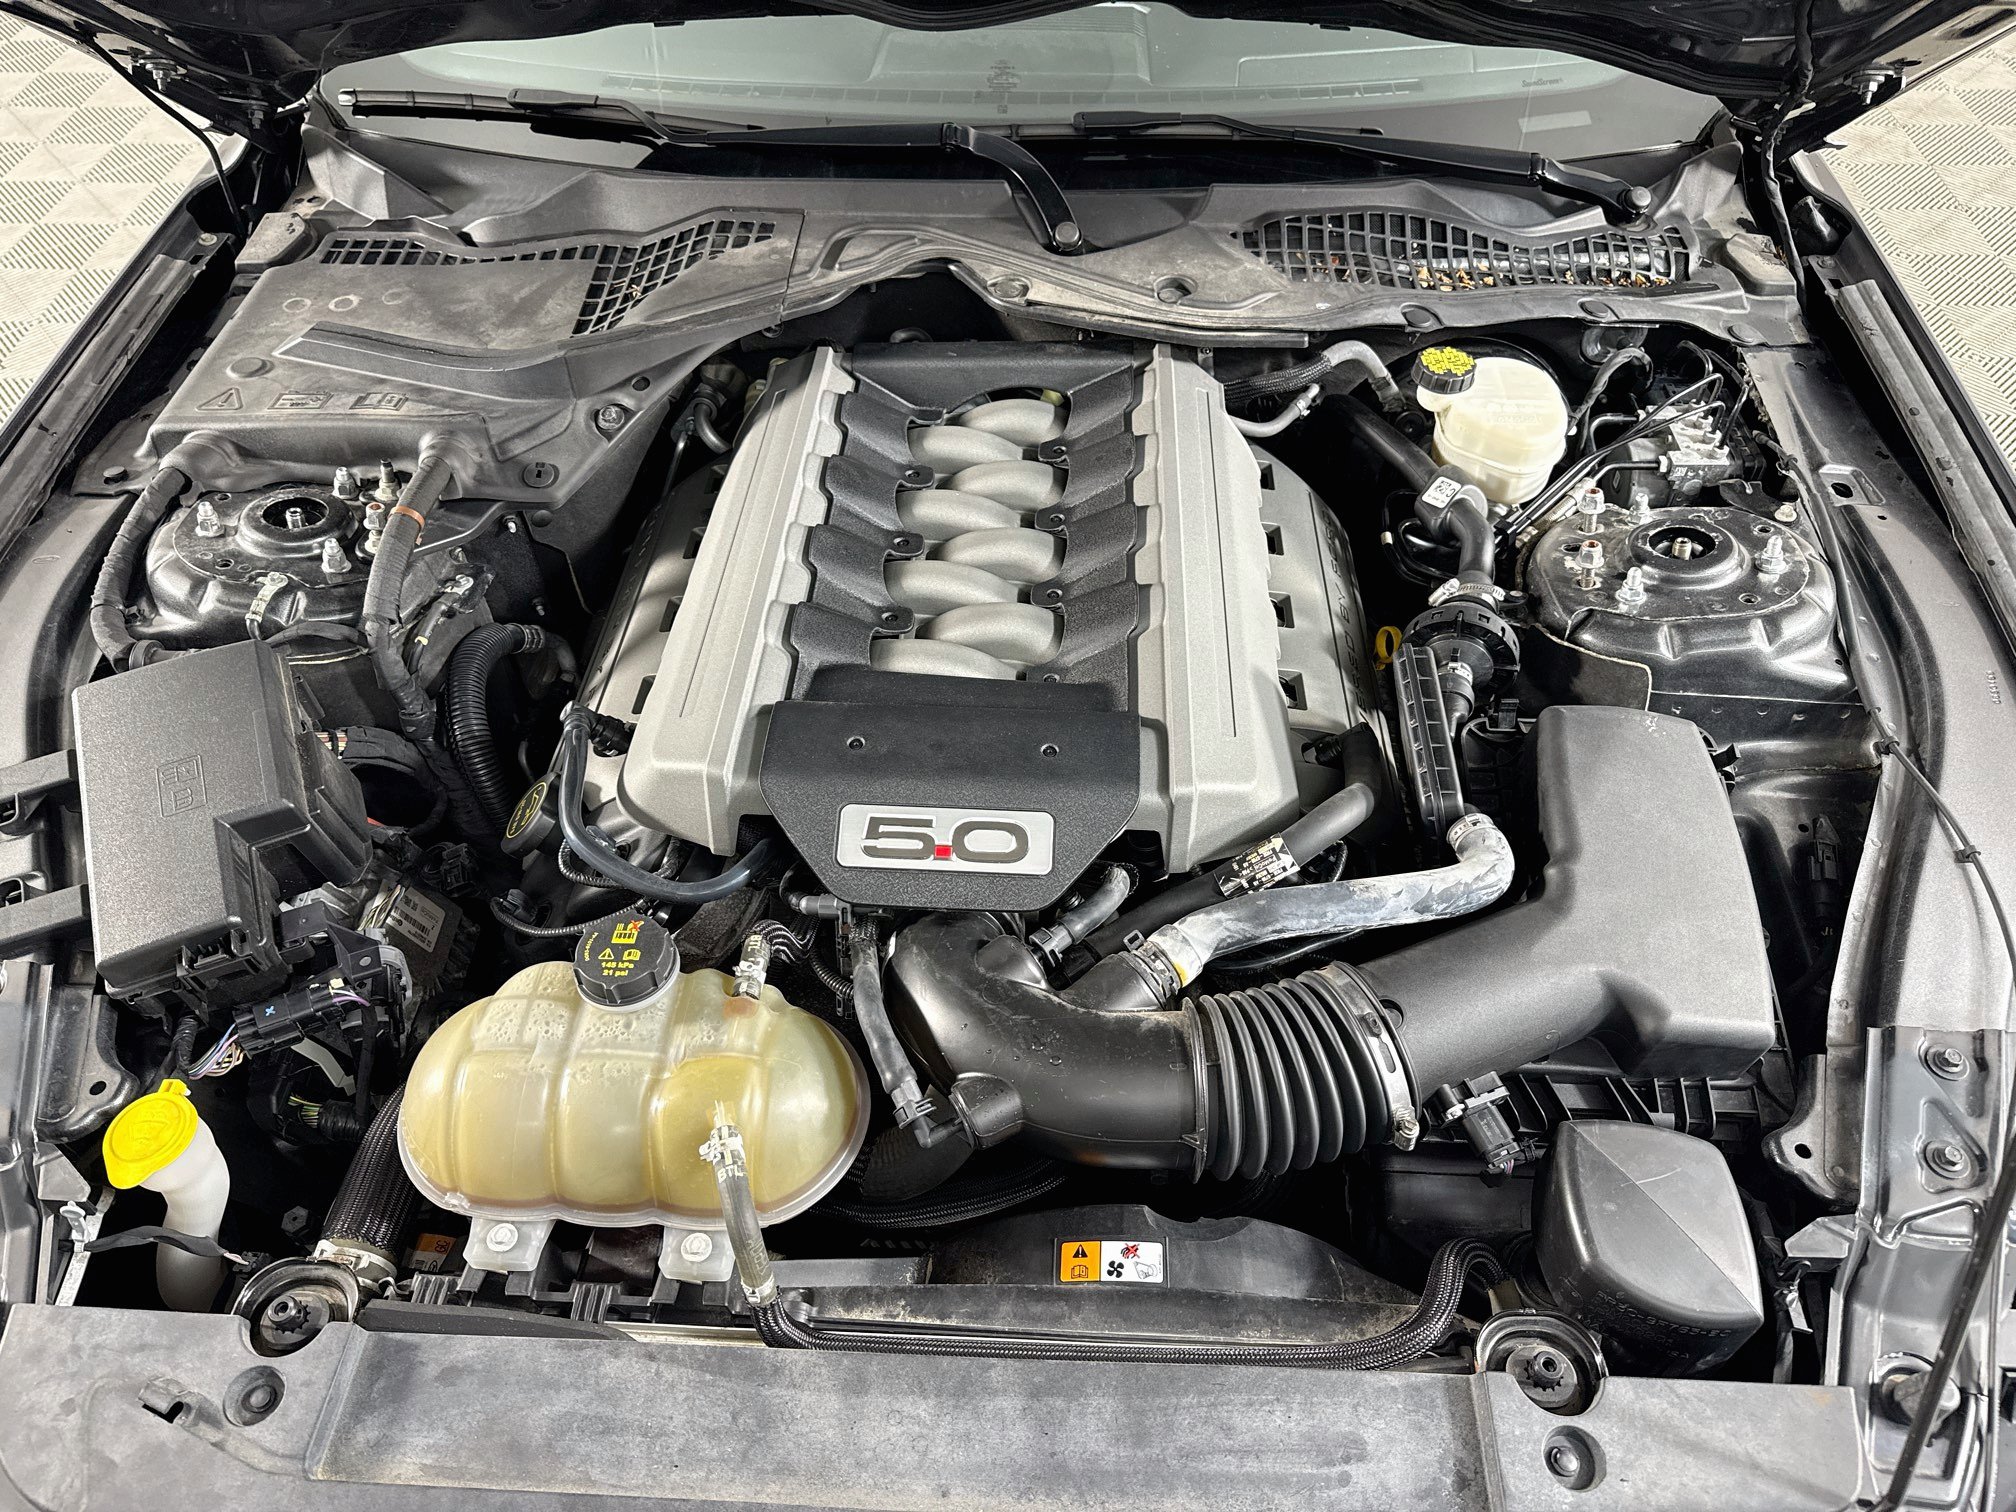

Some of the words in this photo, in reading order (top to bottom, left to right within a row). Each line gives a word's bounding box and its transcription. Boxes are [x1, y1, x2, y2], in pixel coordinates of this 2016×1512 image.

[1334, 582, 1350, 624] BY
[861, 815, 1030, 864] 5.0
[748, 935, 762, 952] BTL
[614, 969, 629, 978] psi
[618, 961, 635, 969] kPa
[717, 1163, 744, 1184] BTL
